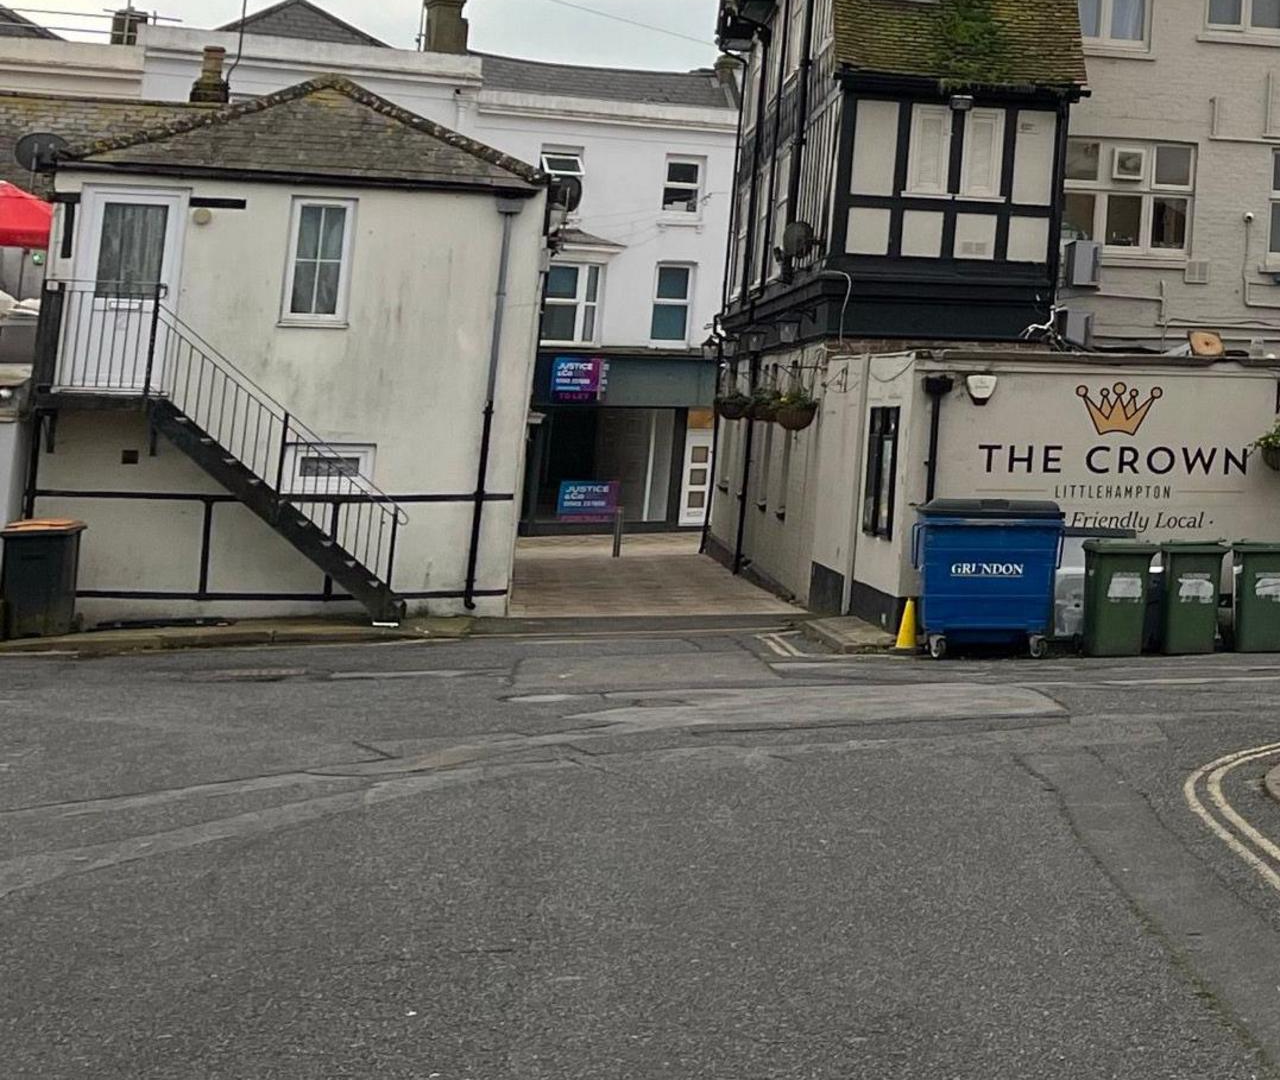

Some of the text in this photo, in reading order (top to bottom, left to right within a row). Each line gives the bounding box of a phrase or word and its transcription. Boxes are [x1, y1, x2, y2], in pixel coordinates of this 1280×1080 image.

[557, 362, 593, 370] JUSTICE
[978, 444, 1249, 475] THE CROWN
[565, 485, 609, 493] JUSTICE
[1054, 485, 1172, 499] LITTLEHAMPTON
[1071, 510, 1205, 533] Friendly Local
